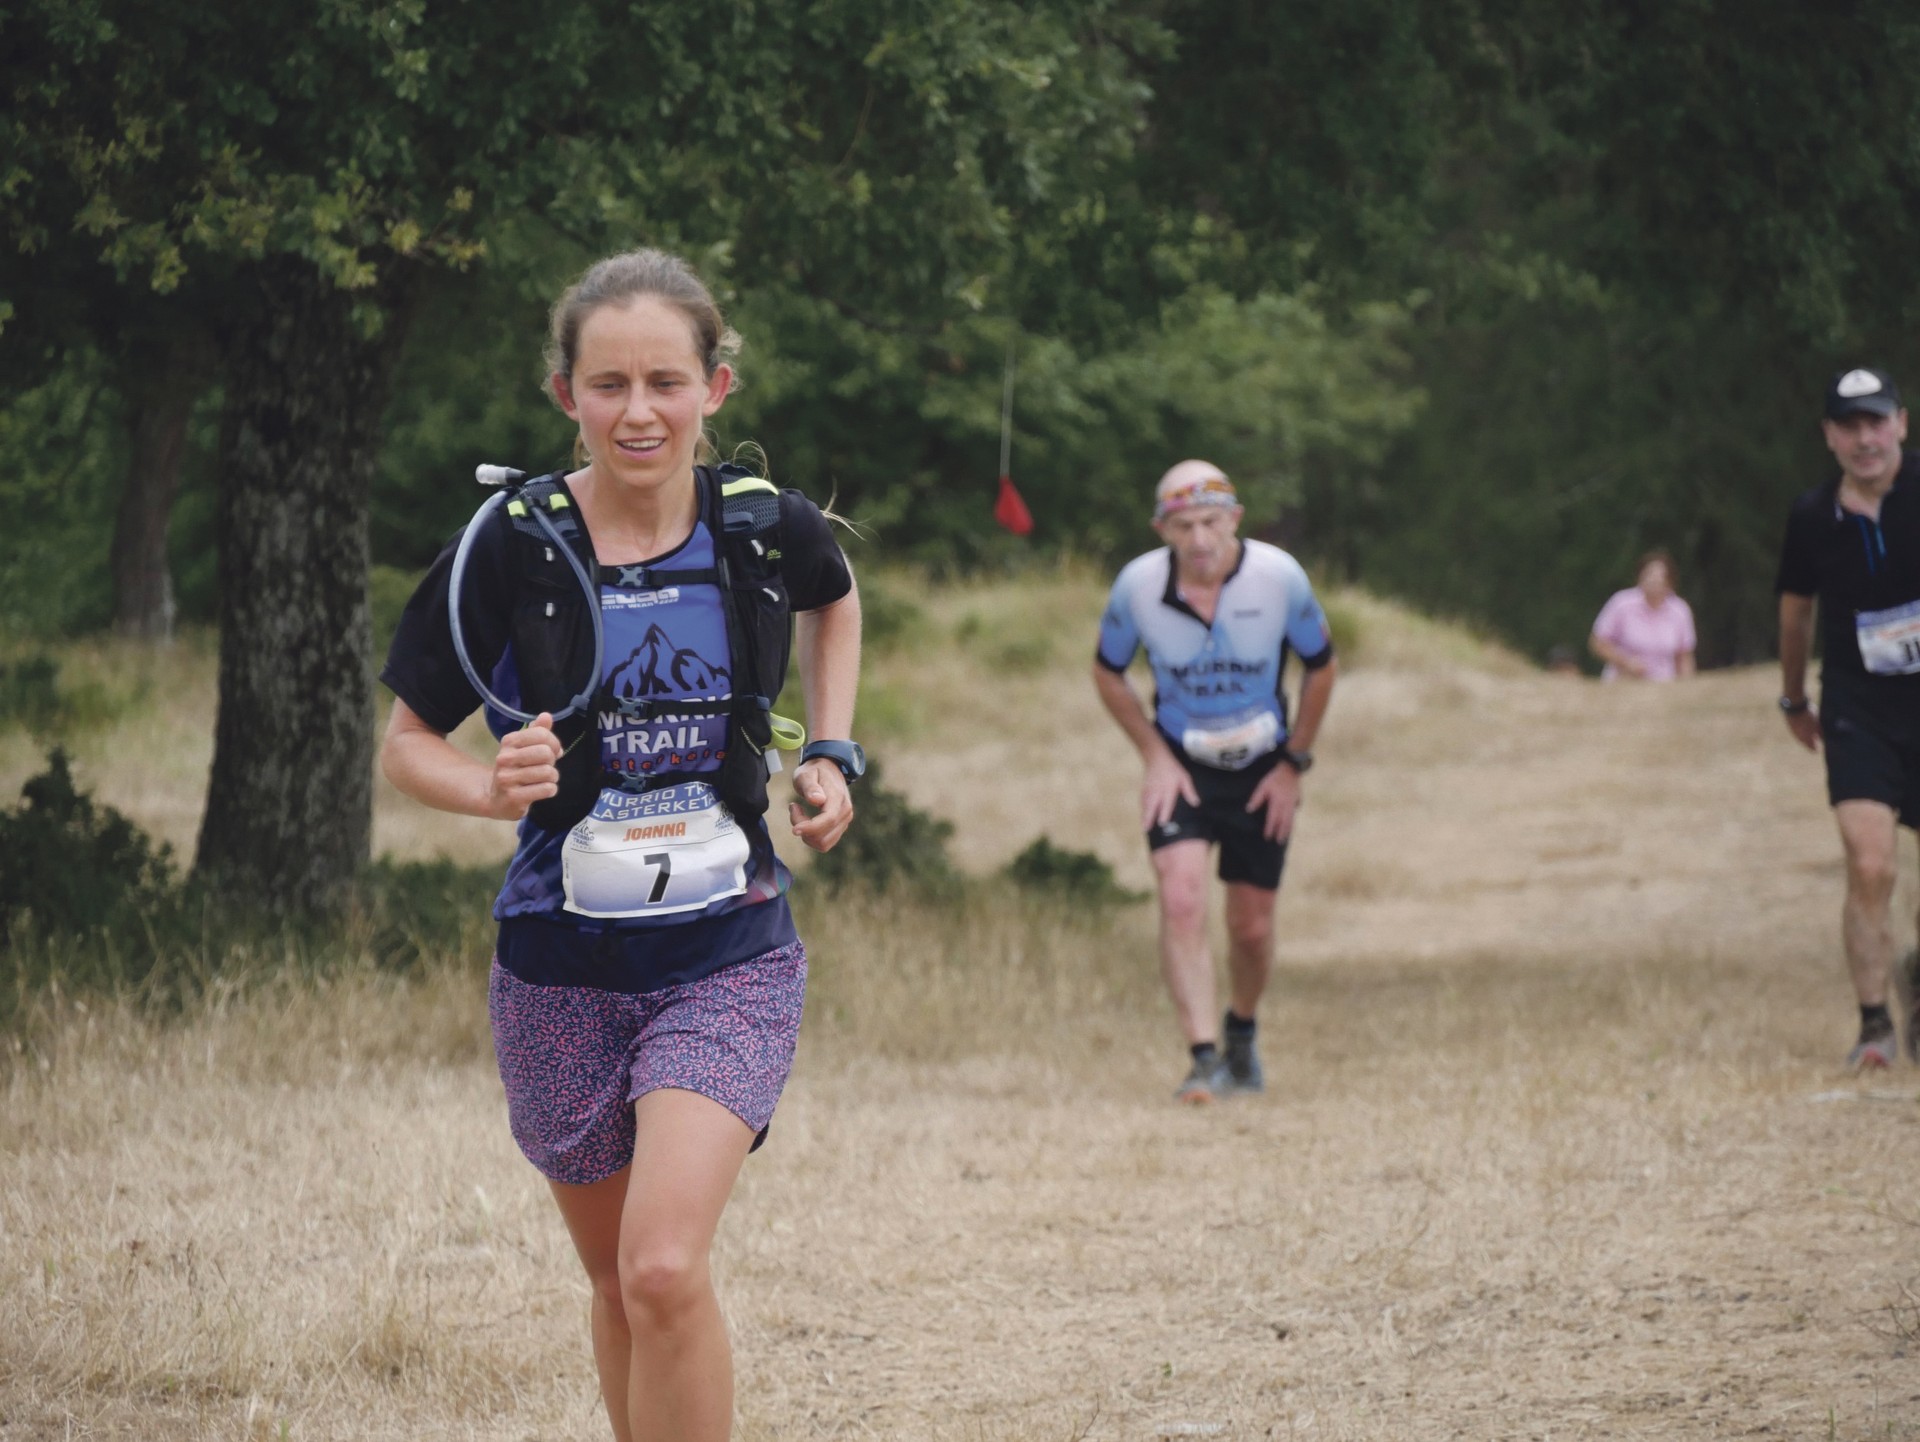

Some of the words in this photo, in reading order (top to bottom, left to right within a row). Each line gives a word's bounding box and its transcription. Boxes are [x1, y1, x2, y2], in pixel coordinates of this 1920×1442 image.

[603, 727, 708, 754] TRAIL
[592, 792, 716, 820] LASTERKETA
[599, 788, 675, 807] MURRIO
[684, 784, 707, 797] TR
[623, 822, 686, 842] JOANNA
[643, 853, 671, 904] 7
